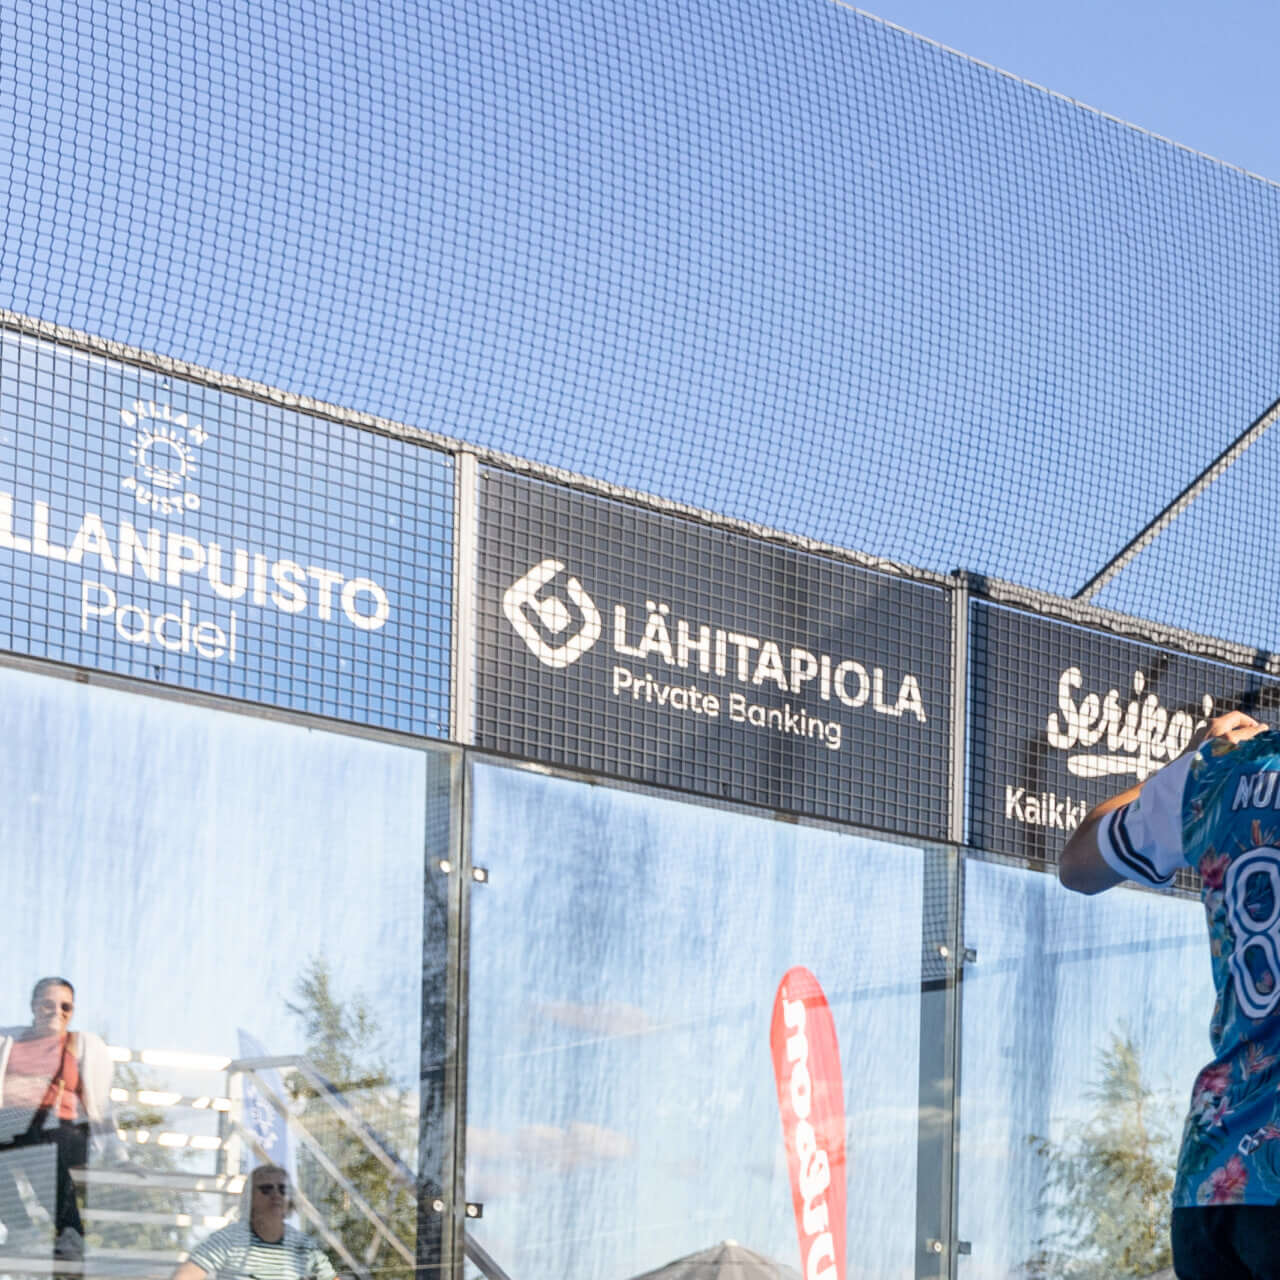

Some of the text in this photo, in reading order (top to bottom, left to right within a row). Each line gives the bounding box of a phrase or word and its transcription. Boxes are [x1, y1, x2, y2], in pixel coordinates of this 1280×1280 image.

[80, 580, 237, 664] Padel
[613, 600, 927, 723] LÄHITAPIOLA
[612, 665, 842, 751] Private Banking
[1005, 784, 1087, 832] Kaikki
